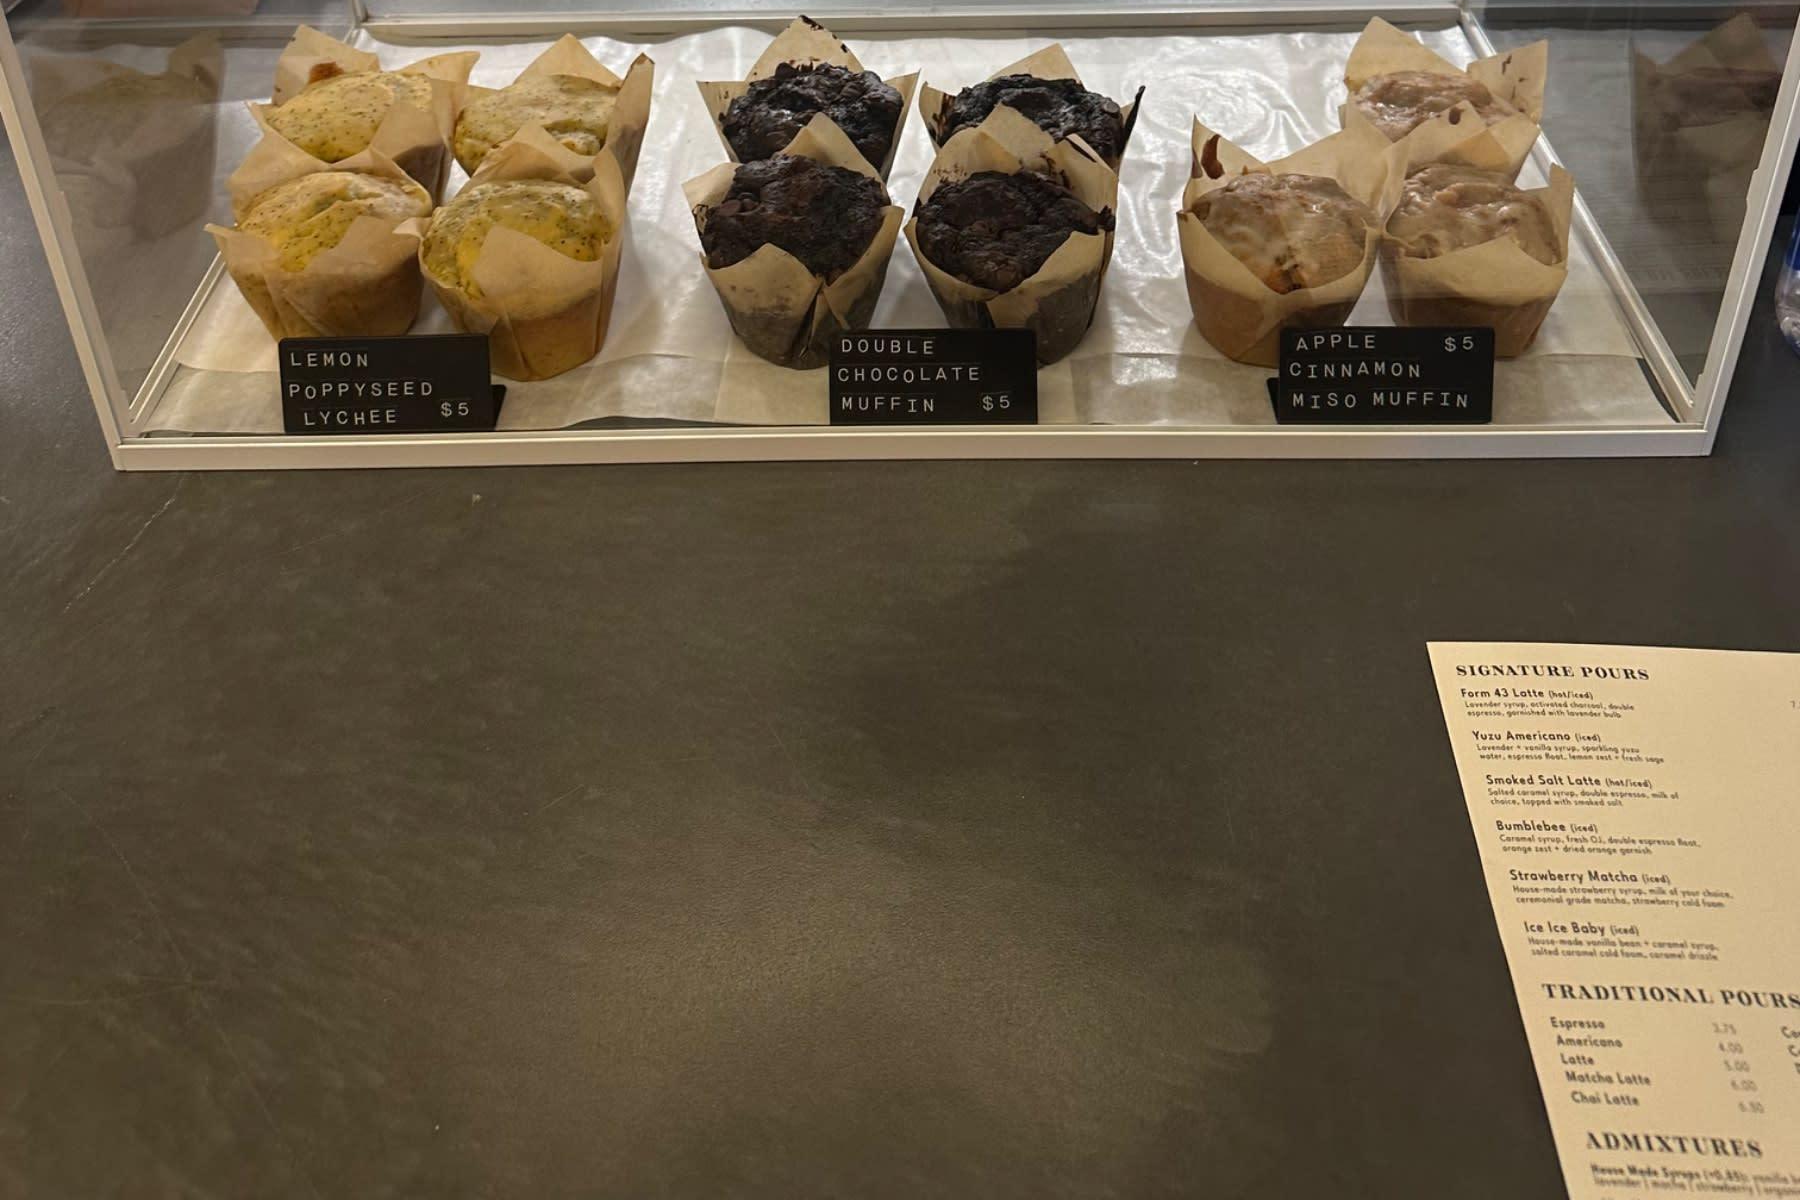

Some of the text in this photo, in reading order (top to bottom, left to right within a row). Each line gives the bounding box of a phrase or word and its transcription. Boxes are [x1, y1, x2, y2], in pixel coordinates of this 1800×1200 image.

[842, 339, 934, 354] DOUBLE
[1296, 334, 1474, 352] APPLE $5
[290, 352, 368, 367] LEMON
[838, 367, 980, 383] CHOCOLATE
[1289, 361, 1420, 378] CINNAMON
[289, 382, 433, 399] POPPYSEED
[843, 395, 1010, 412] MUFFIN $5
[1293, 392, 1468, 409] MISO MUFFIN
[304, 402, 469, 426] LYCHEE $5
[1456, 665, 1649, 680] SIGNATURE POURS
[1461, 688, 1593, 700] Form 43 Latte (hot/iced)
[1507, 710, 1545, 718] garnished
[1608, 703, 1634, 711] double
[1472, 731, 1601, 742] Yuzu Americano (iced)
[1582, 745, 1618, 754] sparkling
[1486, 775, 1652, 789] Smoked Salt Latte (hot/iced)
[1488, 788, 1514, 796] Salted
[1522, 798, 1551, 807] topped
[1496, 820, 1598, 833] Bumblebee (iced)
[1499, 835, 1535, 843] Caramel
[1563, 845, 1585, 853] dried
[1587, 847, 1617, 855] orange
[1509, 869, 1671, 884] Strawberry Matcha (iced)
[1569, 886, 1616, 896] strawberry
[1516, 895, 1562, 904] ceremonial
[1566, 897, 1591, 906] grade
[1524, 921, 1639, 936] Ice Ice Baby (iced)
[1542, 983, 1800, 1008] TRADITIONAL POURS
[1550, 1016, 1605, 1030] Espresso
[1556, 1035, 1623, 1048] Americano
[1560, 1053, 1594, 1065] Latte
[1565, 1071, 1612, 1084] Matcha
[1617, 1072, 1651, 1086] Latte
[1570, 1091, 1600, 1104] Chai
[1605, 1092, 1639, 1106] Latte
[1587, 1131, 1763, 1158] ADMIXTURES
